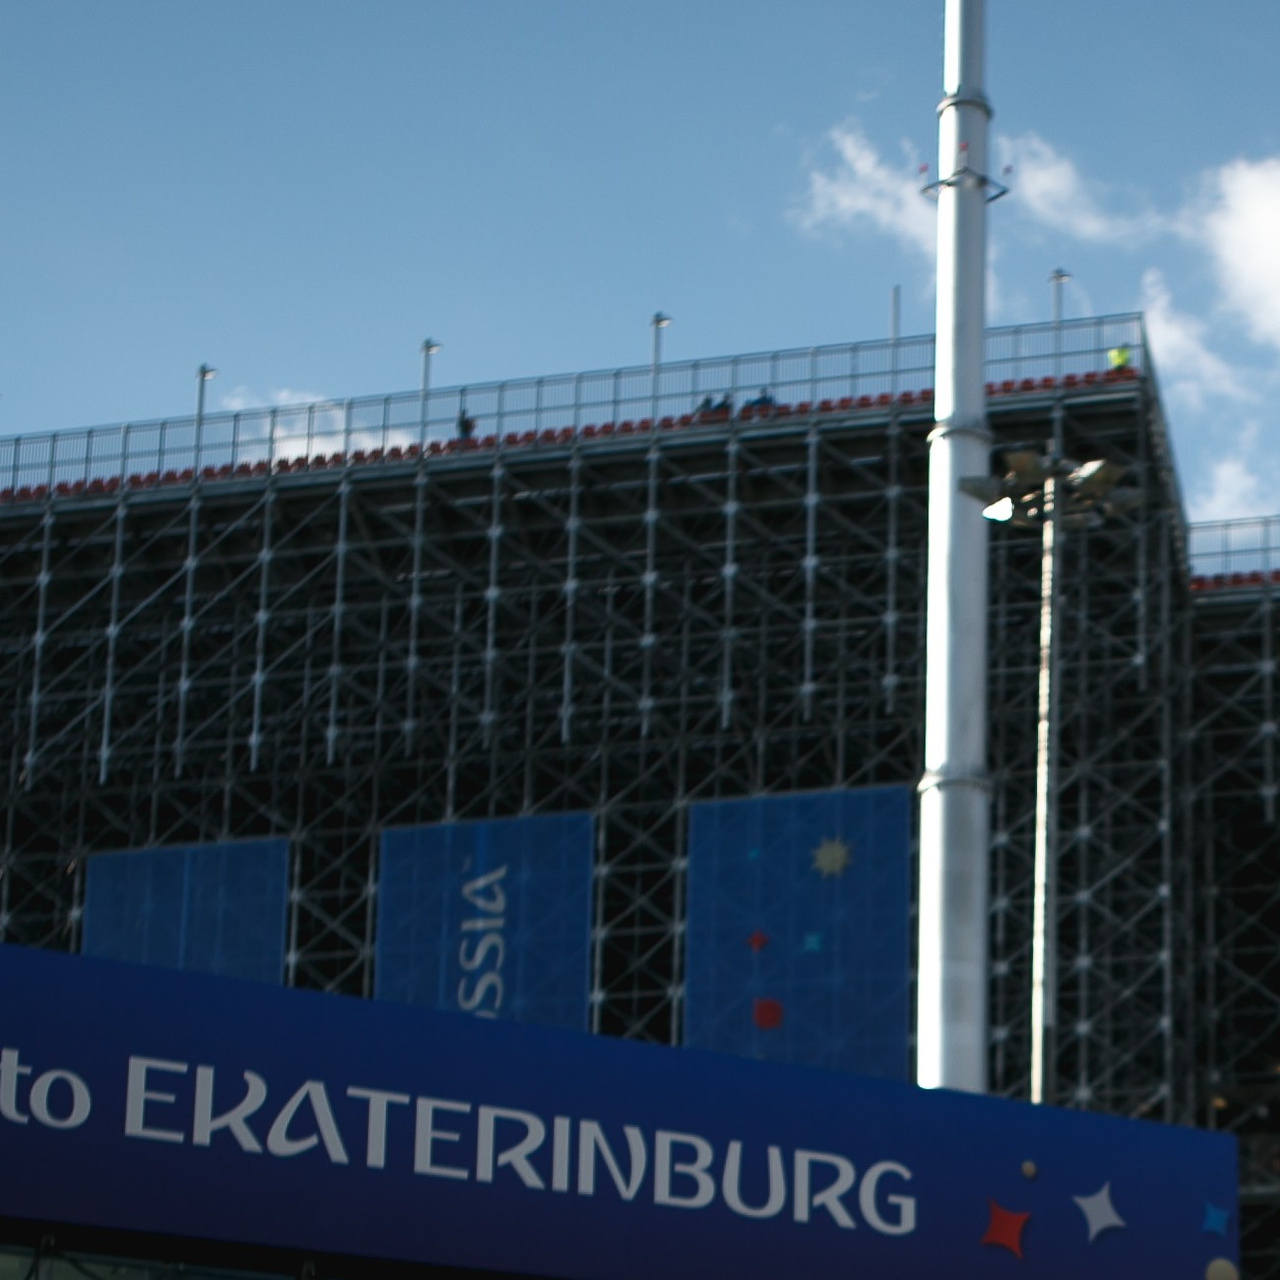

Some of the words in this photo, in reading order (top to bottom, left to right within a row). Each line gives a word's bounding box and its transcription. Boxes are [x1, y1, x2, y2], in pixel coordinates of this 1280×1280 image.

[457, 864, 509, 1019] SSIA
[0, 1048, 92, 1129] to
[125, 1055, 918, 1235] EKATERINBURG
